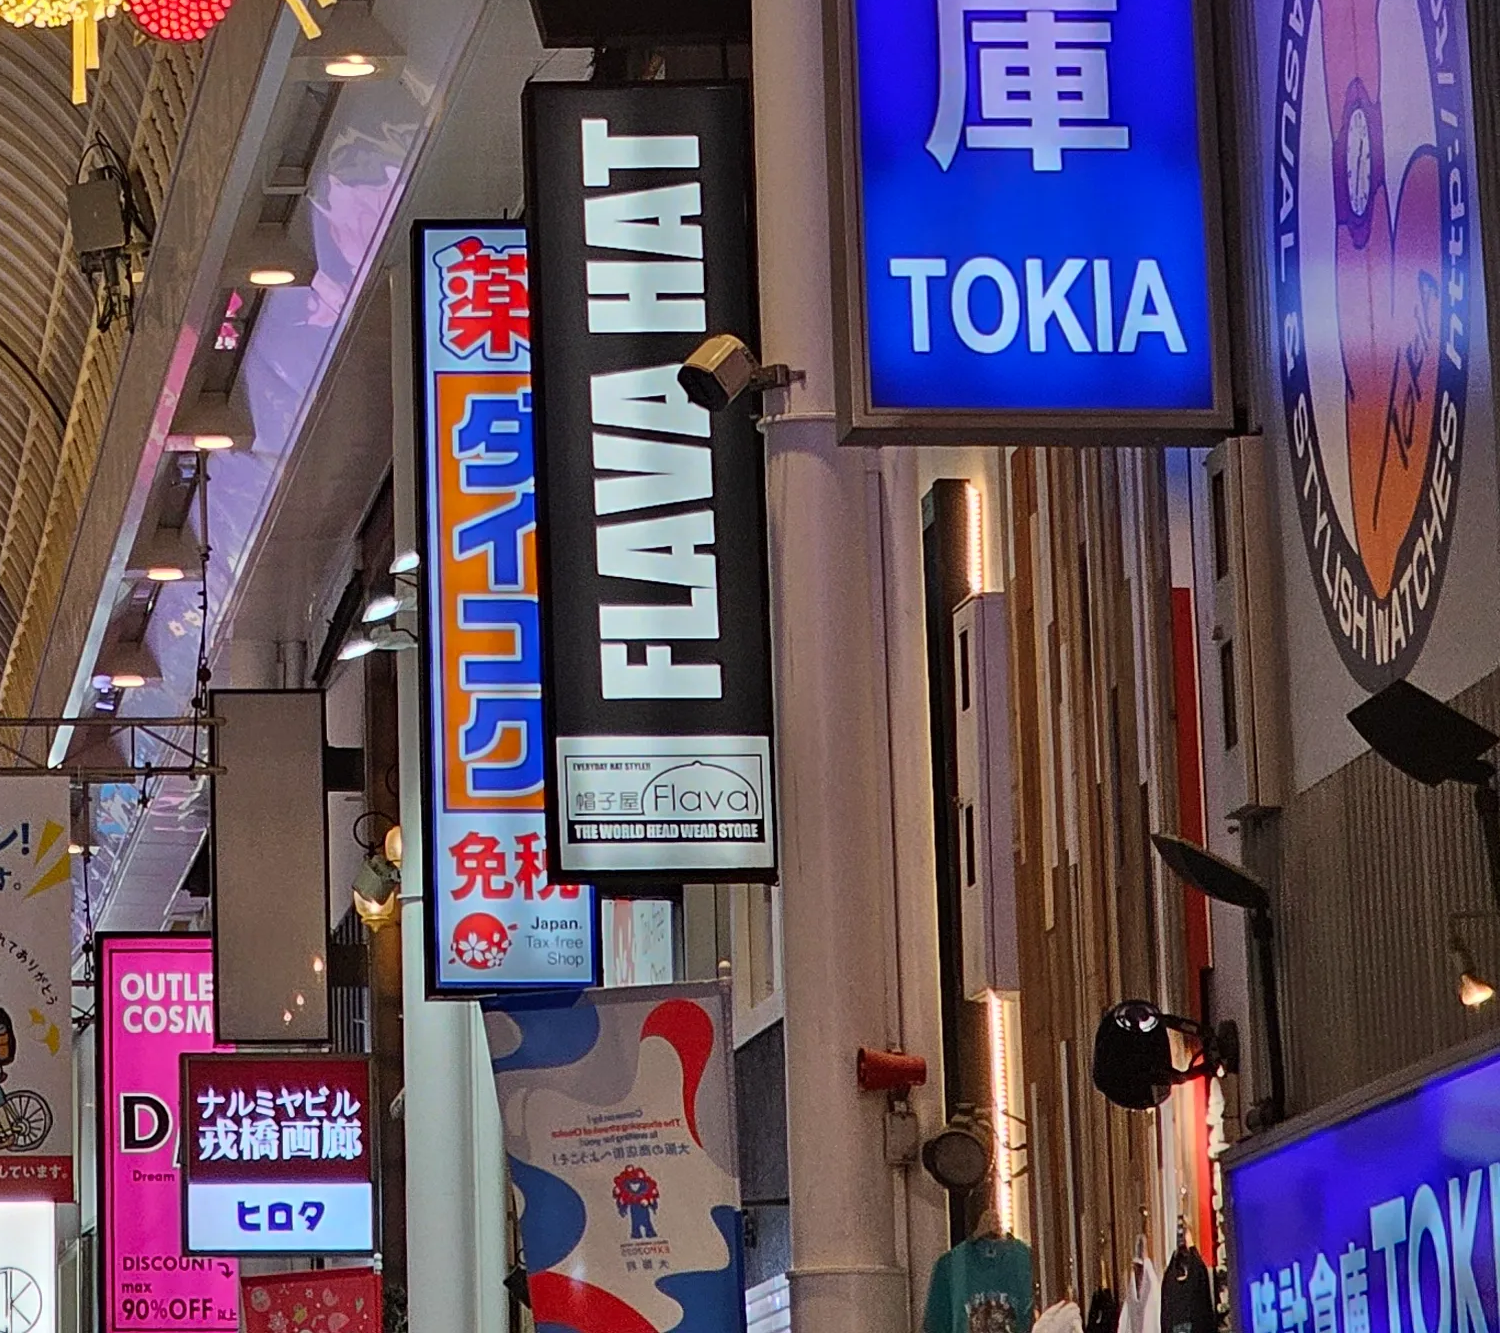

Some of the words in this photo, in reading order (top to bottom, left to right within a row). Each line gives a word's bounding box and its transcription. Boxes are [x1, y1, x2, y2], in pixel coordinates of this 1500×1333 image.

[581, 118, 707, 334] HAT
[889, 255, 1188, 355] TOKIA
[590, 362, 723, 701] FLAVA
[1293, 392, 1368, 661] STYLISH
[1372, 389, 1458, 666] WATCHES
[575, 791, 639, 811] 帽子屋
[653, 784, 750, 812] Flava
[574, 824, 599, 840] THE
[599, 823, 645, 839] WORLD
[646, 823, 679, 839] HEAD
[681, 823, 717, 839] WEAR
[718, 823, 759, 838] STORE
[531, 916, 583, 933] Japan.
[547, 952, 584, 967] Shop
[196, 1085, 362, 1119] ナルミヤビル
[197, 1116, 364, 1161] 戎橋画廊
[132, 1170, 175, 1182] Dream
[237, 1200, 325, 1232] ヒロタ
[121, 1283, 153, 1294] max
[121, 1297, 214, 1321] 90%OFF
